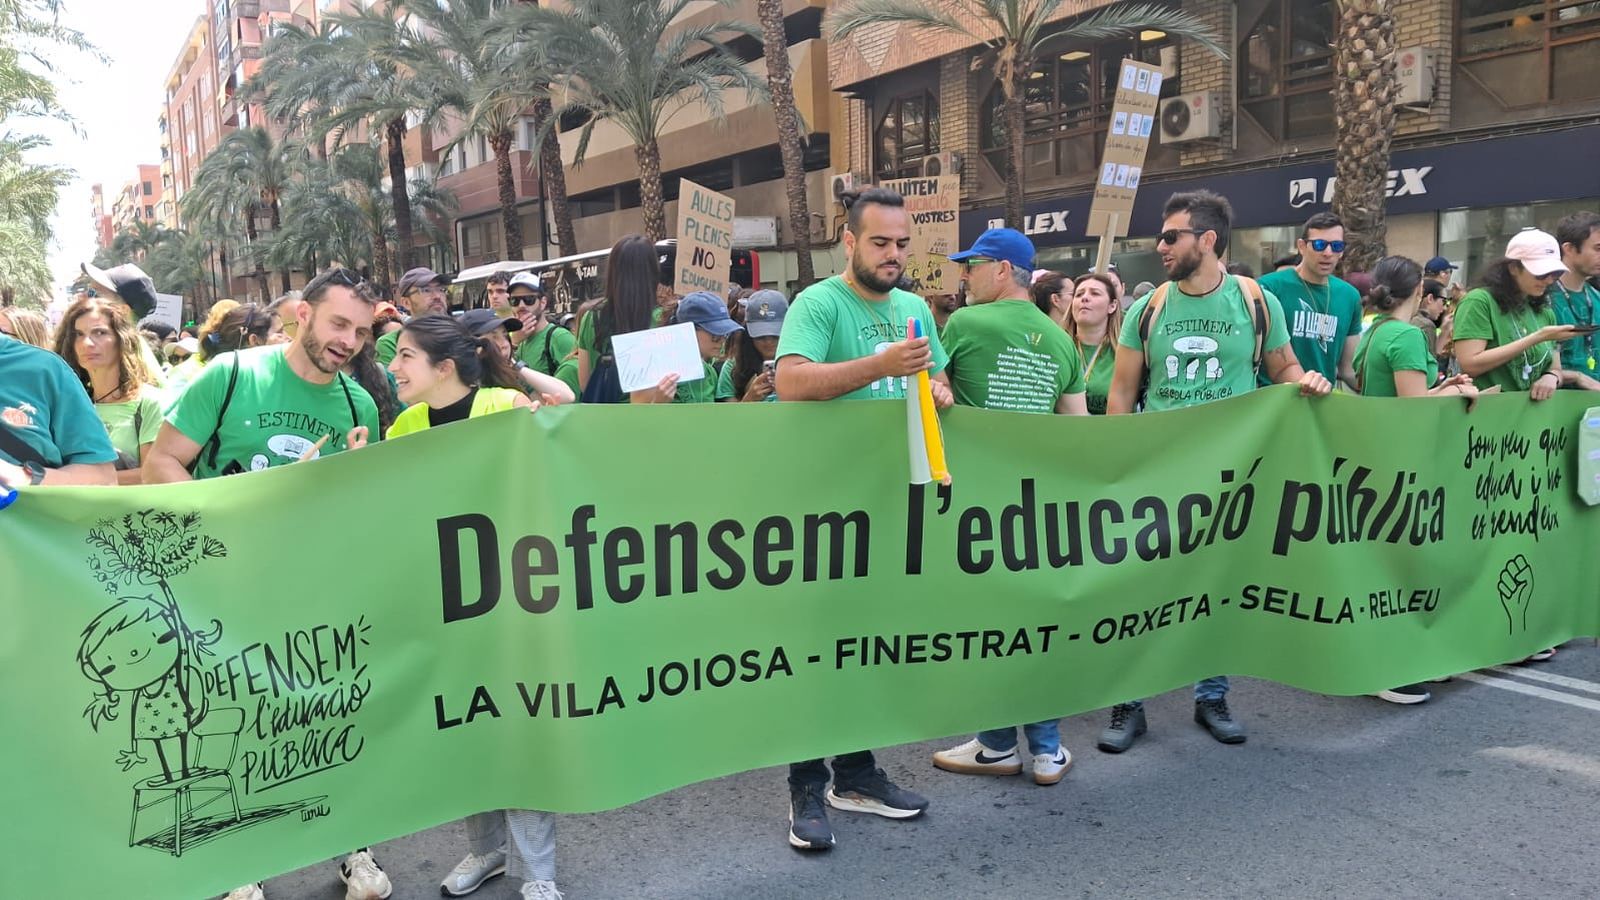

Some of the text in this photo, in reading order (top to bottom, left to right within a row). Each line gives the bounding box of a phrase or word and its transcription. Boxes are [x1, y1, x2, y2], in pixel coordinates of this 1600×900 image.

[1402, 69, 1413, 77] LG
[691, 190, 732, 222] AULES
[912, 211, 956, 225] VOSTRES
[1024, 210, 1070, 235] LEX
[684, 217, 731, 251] PLENES
[692, 246, 716, 270] NO
[861, 322, 909, 341] ESTIME
[1165, 319, 1232, 336] ESTIMEM
[1293, 310, 1305, 332] LA
[1194, 386, 1233, 400] PÚBLICA
[257, 411, 342, 448] ESTIMEM
[1464, 426, 1497, 469] Som
[1501, 430, 1531, 462] veu
[1540, 427, 1567, 467] que
[1476, 461, 1561, 509] educa i no
[1472, 495, 1559, 542] es rendeix
[437, 504, 870, 625] Defensem
[905, 457, 1263, 575] l'educació
[1272, 457, 1446, 556] pública
[204, 623, 357, 701] DEFENSEM
[434, 686, 501, 731] LA
[516, 676, 625, 719] VILA
[637, 646, 794, 703] JOIOSA
[807, 654, 821, 664] -
[835, 624, 1059, 670] FINESTRAT
[1068, 633, 1081, 641] -
[1092, 593, 1211, 645] ORXETA
[1239, 585, 1355, 625] SELLA
[1369, 587, 1441, 620] RELLEU
[247, 664, 371, 741] l'educació
